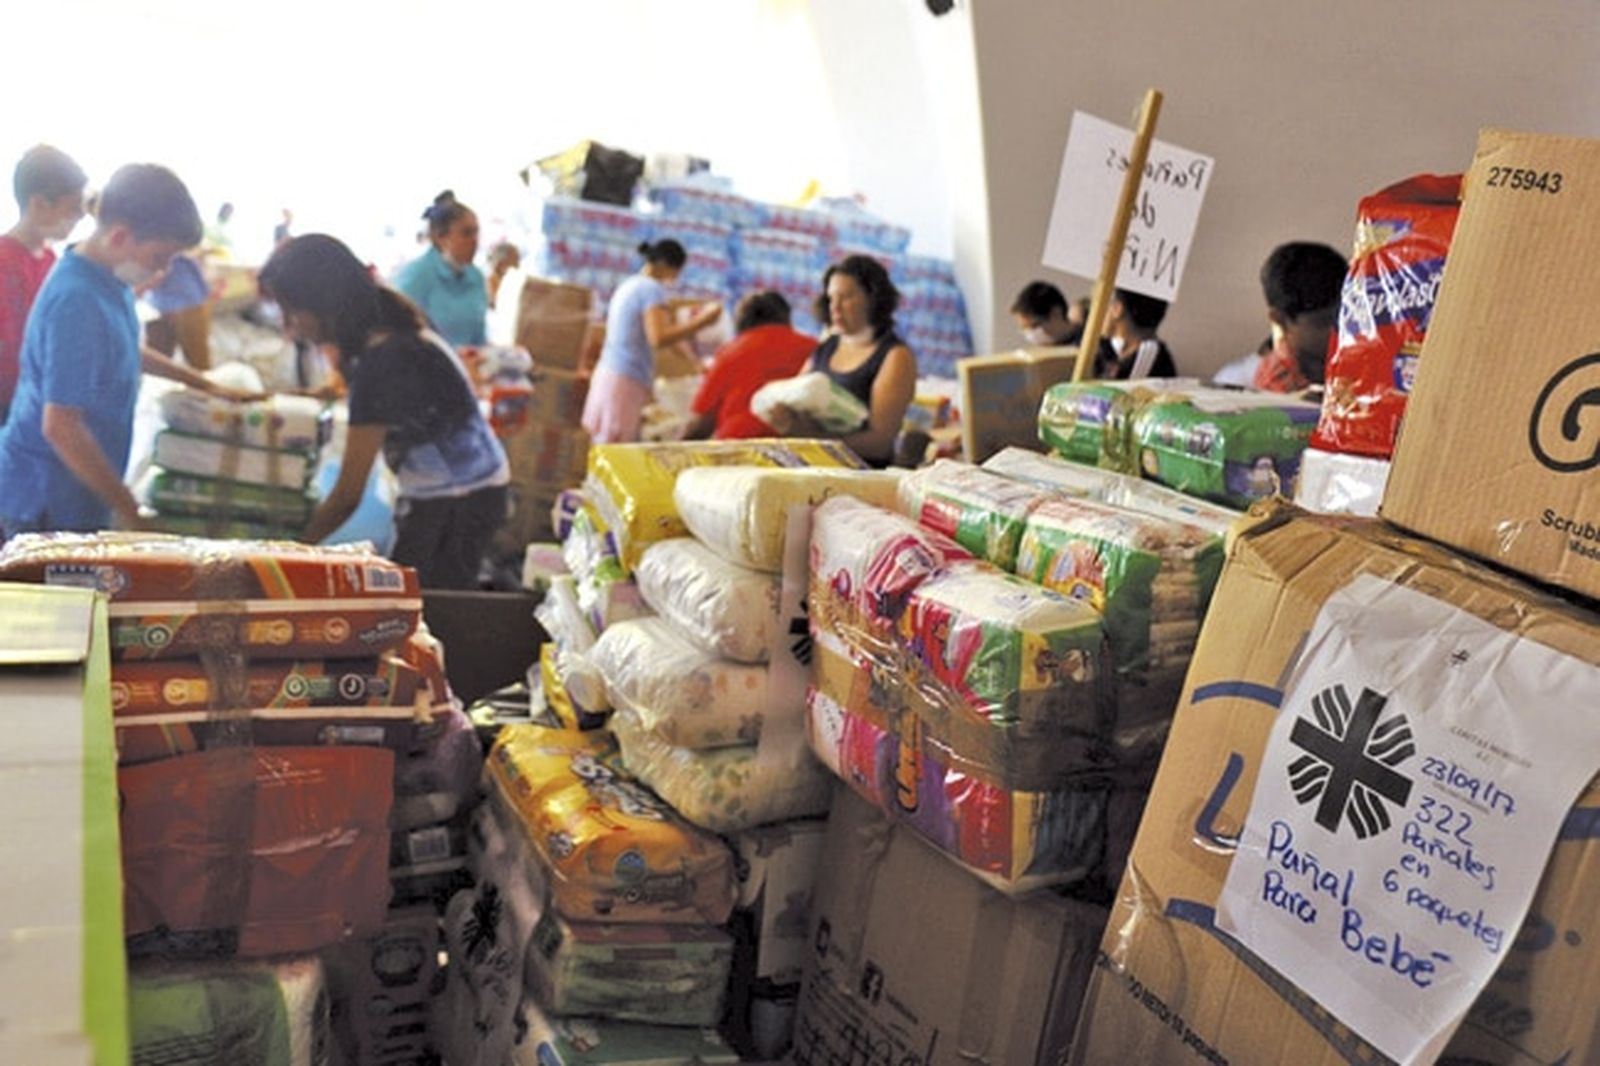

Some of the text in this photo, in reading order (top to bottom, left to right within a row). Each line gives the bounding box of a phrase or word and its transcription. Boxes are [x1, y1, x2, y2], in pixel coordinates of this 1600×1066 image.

[1487, 166, 1562, 194] 275943
[1402, 820, 1497, 892] Pañales
[1415, 796, 1473, 847] 322
[1267, 820, 1354, 907] Pañal
[1400, 853, 1430, 879] en
[1262, 869, 1318, 923] Para
[1341, 908, 1454, 988] Bebé
[1383, 868, 1504, 954] 6 paquetes
